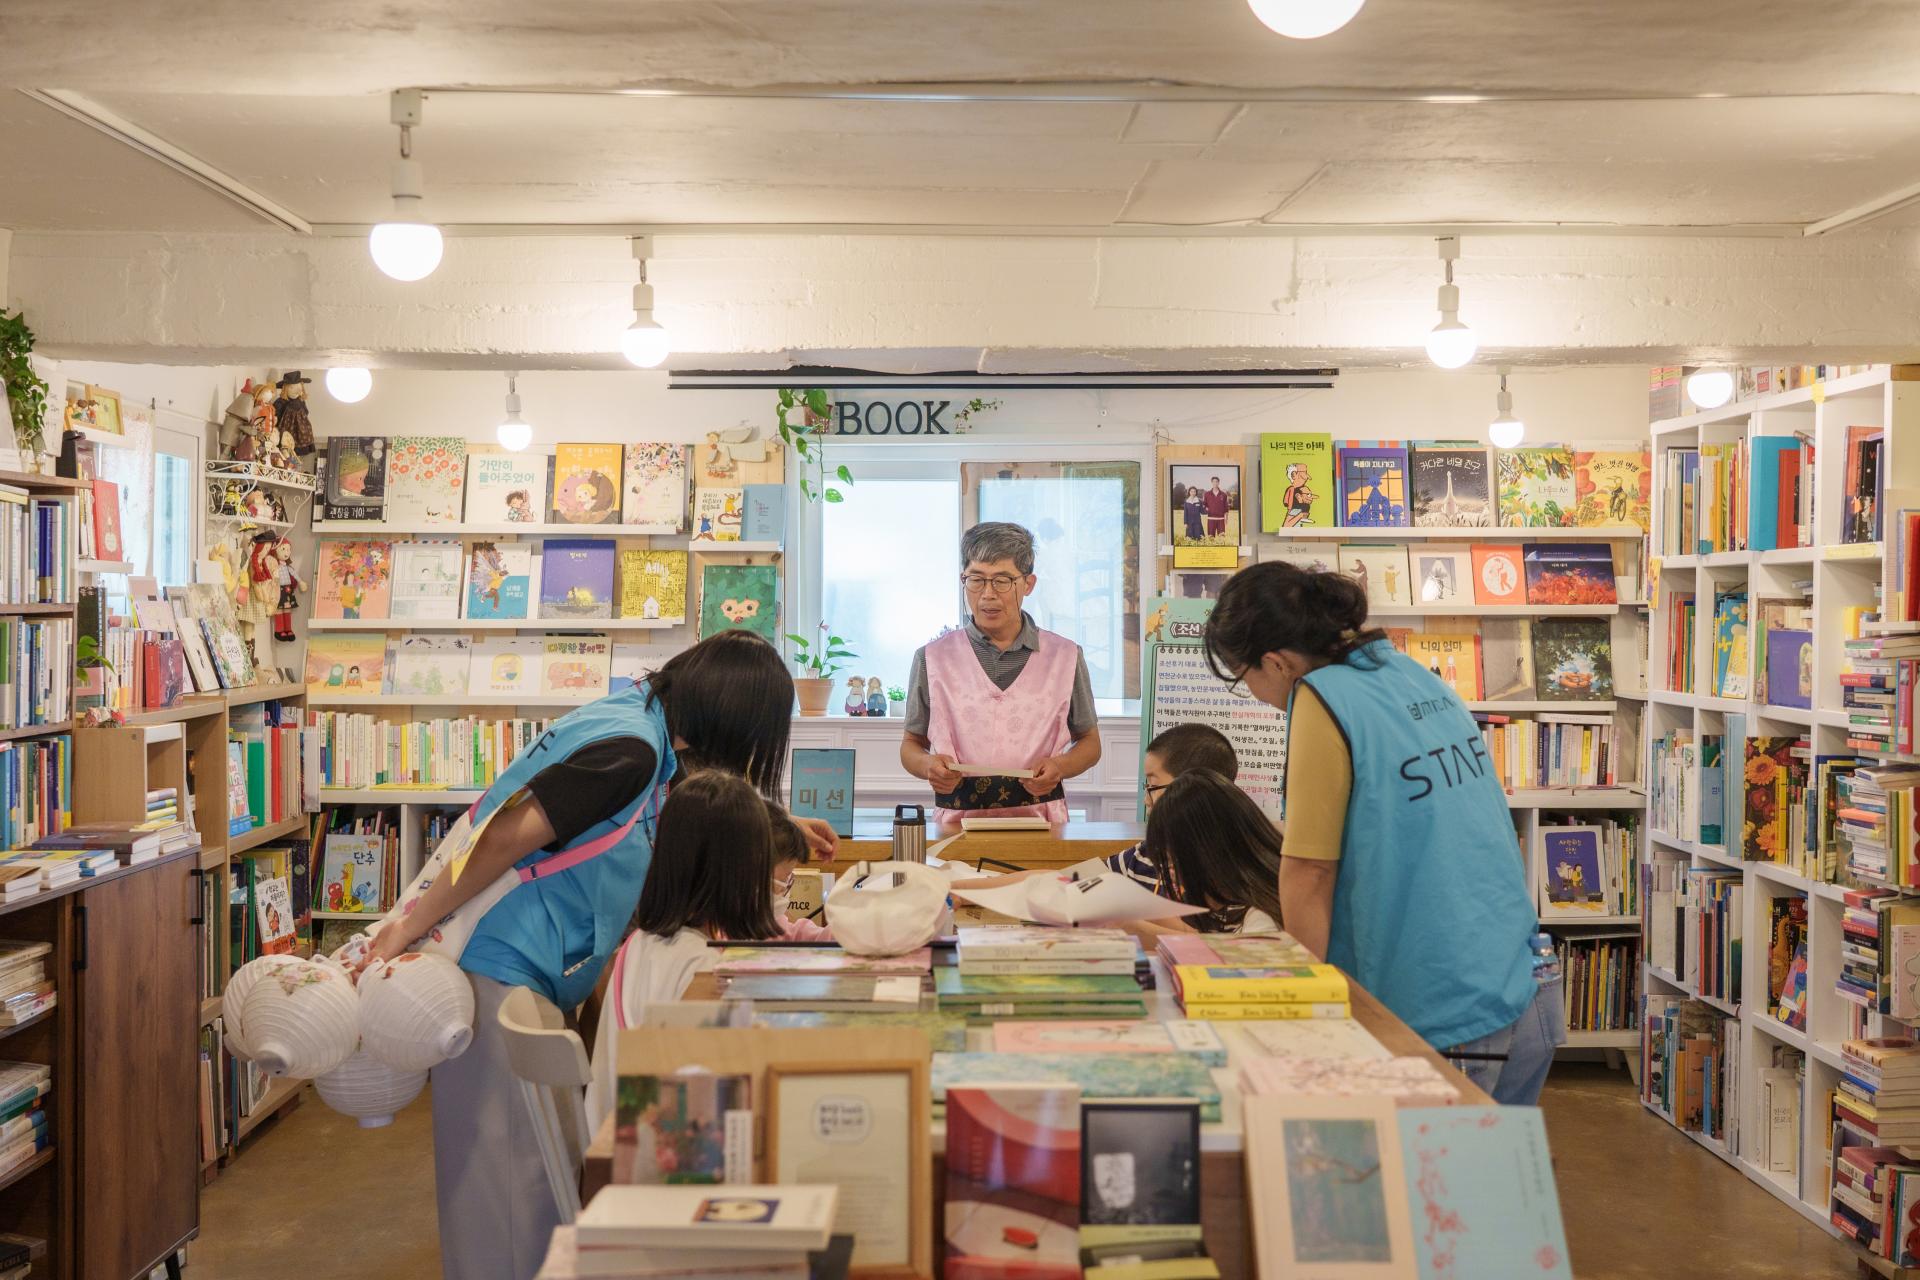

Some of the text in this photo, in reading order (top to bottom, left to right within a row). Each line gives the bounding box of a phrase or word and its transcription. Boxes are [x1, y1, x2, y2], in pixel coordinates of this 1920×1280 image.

[834, 400, 951, 435] BOOK
[1270, 441, 1325, 451] 나의 작은 아빠
[479, 459, 513, 472] 가만히
[479, 472, 536, 484] 들어주었어
[1263, 762, 1285, 771] 비판했
[353, 850, 376, 866] 단추
